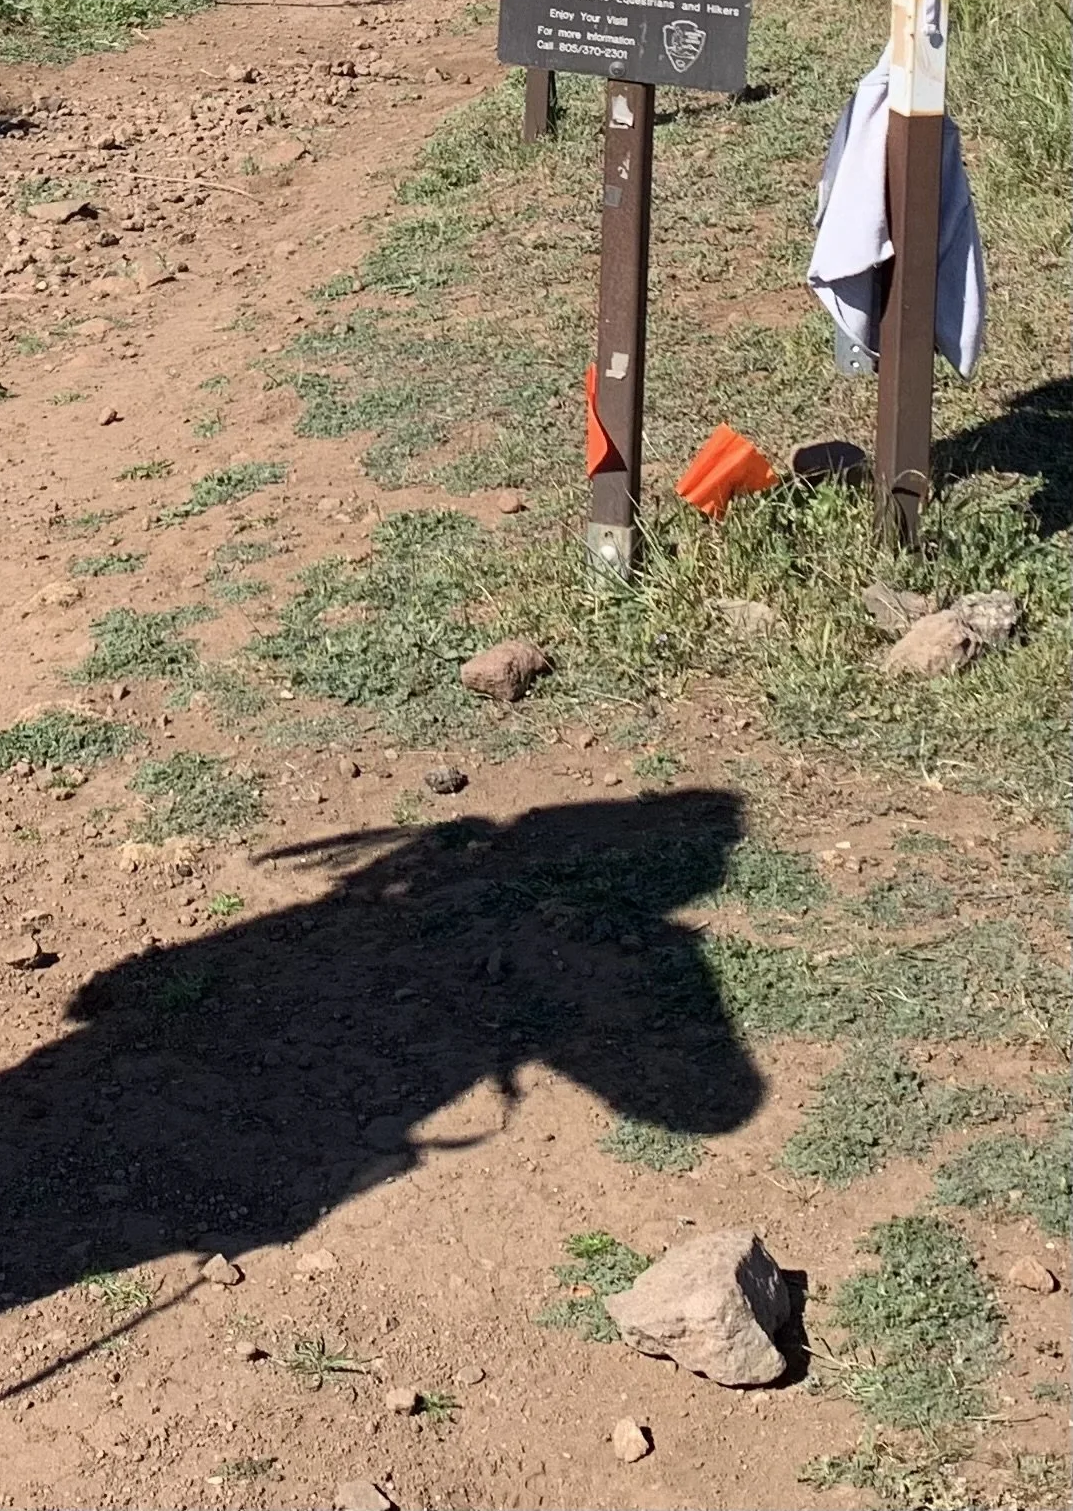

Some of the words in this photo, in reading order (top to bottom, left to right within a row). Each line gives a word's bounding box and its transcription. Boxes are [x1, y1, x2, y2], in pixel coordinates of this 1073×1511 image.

[549, 8, 574, 21] Enjoy
[580, 12, 600, 23] Your
[681, 1, 700, 12] and
[707, 4, 739, 17] Hikers
[538, 26, 552, 35] For
[558, 29, 581, 39] more
[537, 40, 553, 50] Call
[559, 42, 628, 59] 805/370-2301
